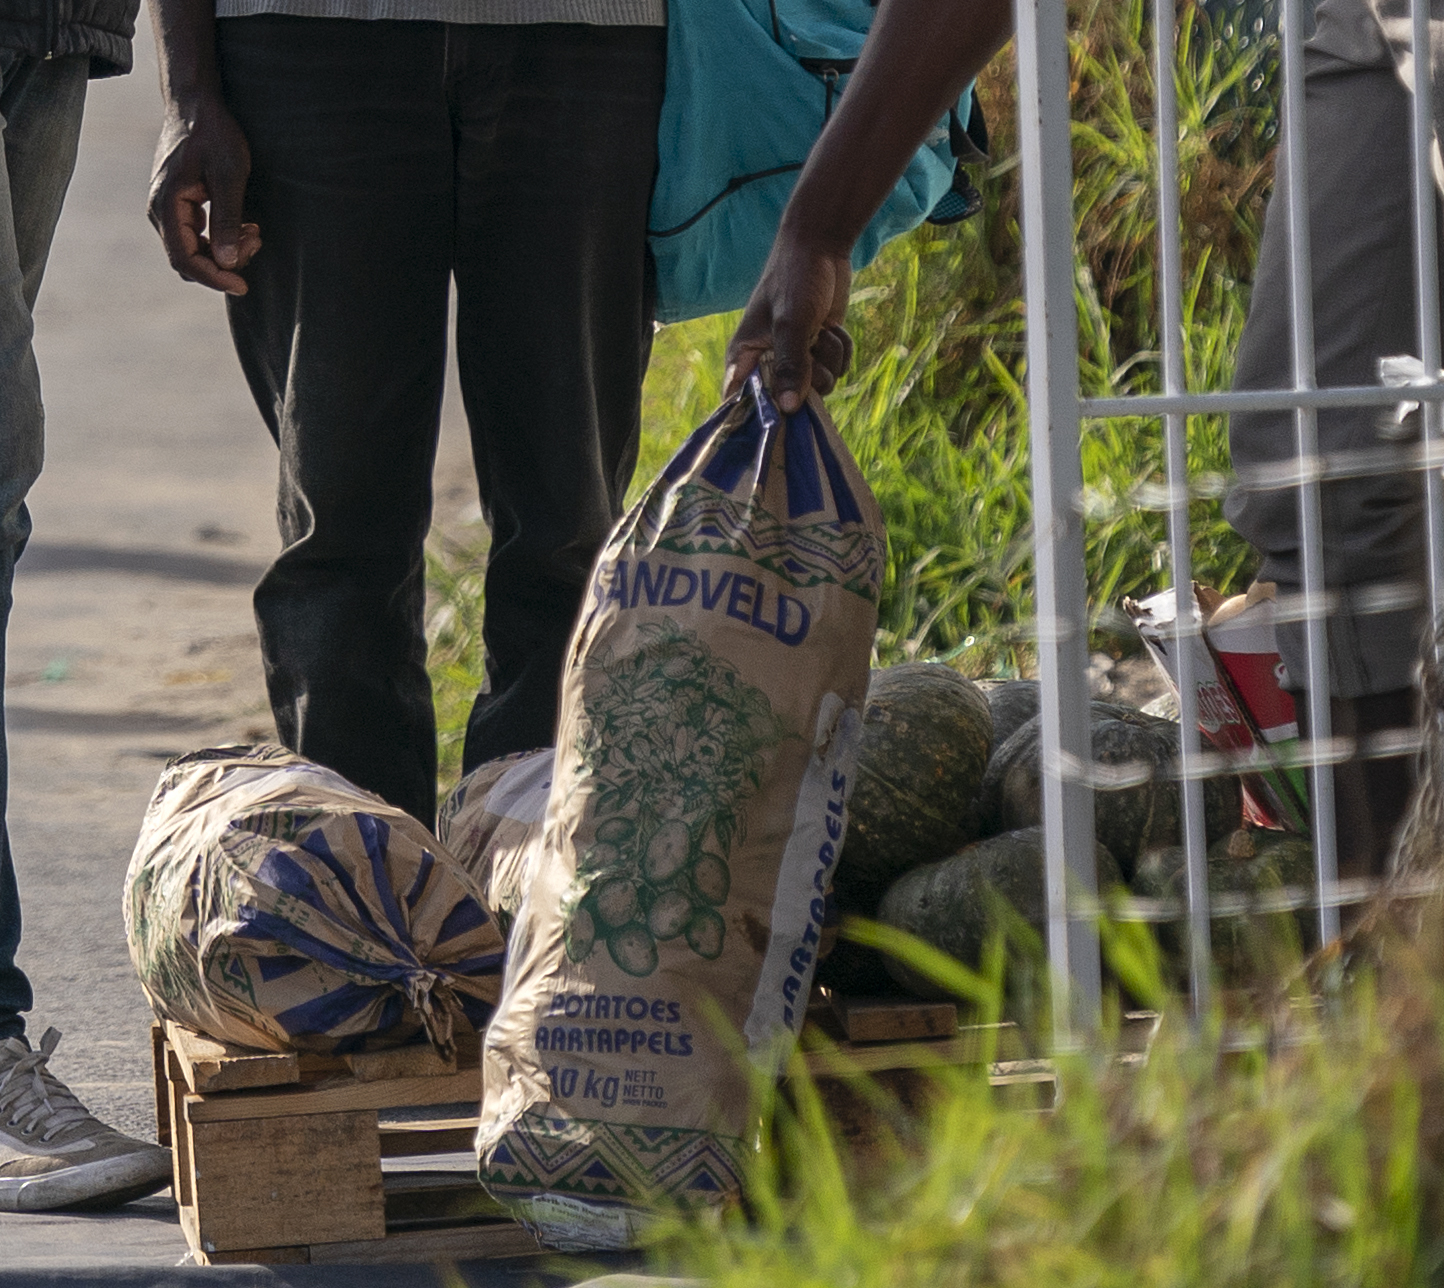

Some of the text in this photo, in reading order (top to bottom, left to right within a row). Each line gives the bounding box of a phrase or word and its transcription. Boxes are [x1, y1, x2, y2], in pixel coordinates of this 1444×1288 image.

[550, 994, 681, 1024] POTATOES
[535, 1026, 694, 1057] AARTAPPELS
[547, 1065, 620, 1108] 10 kg
[624, 1069, 658, 1083] NETT
[623, 1085, 664, 1099] NETTO
